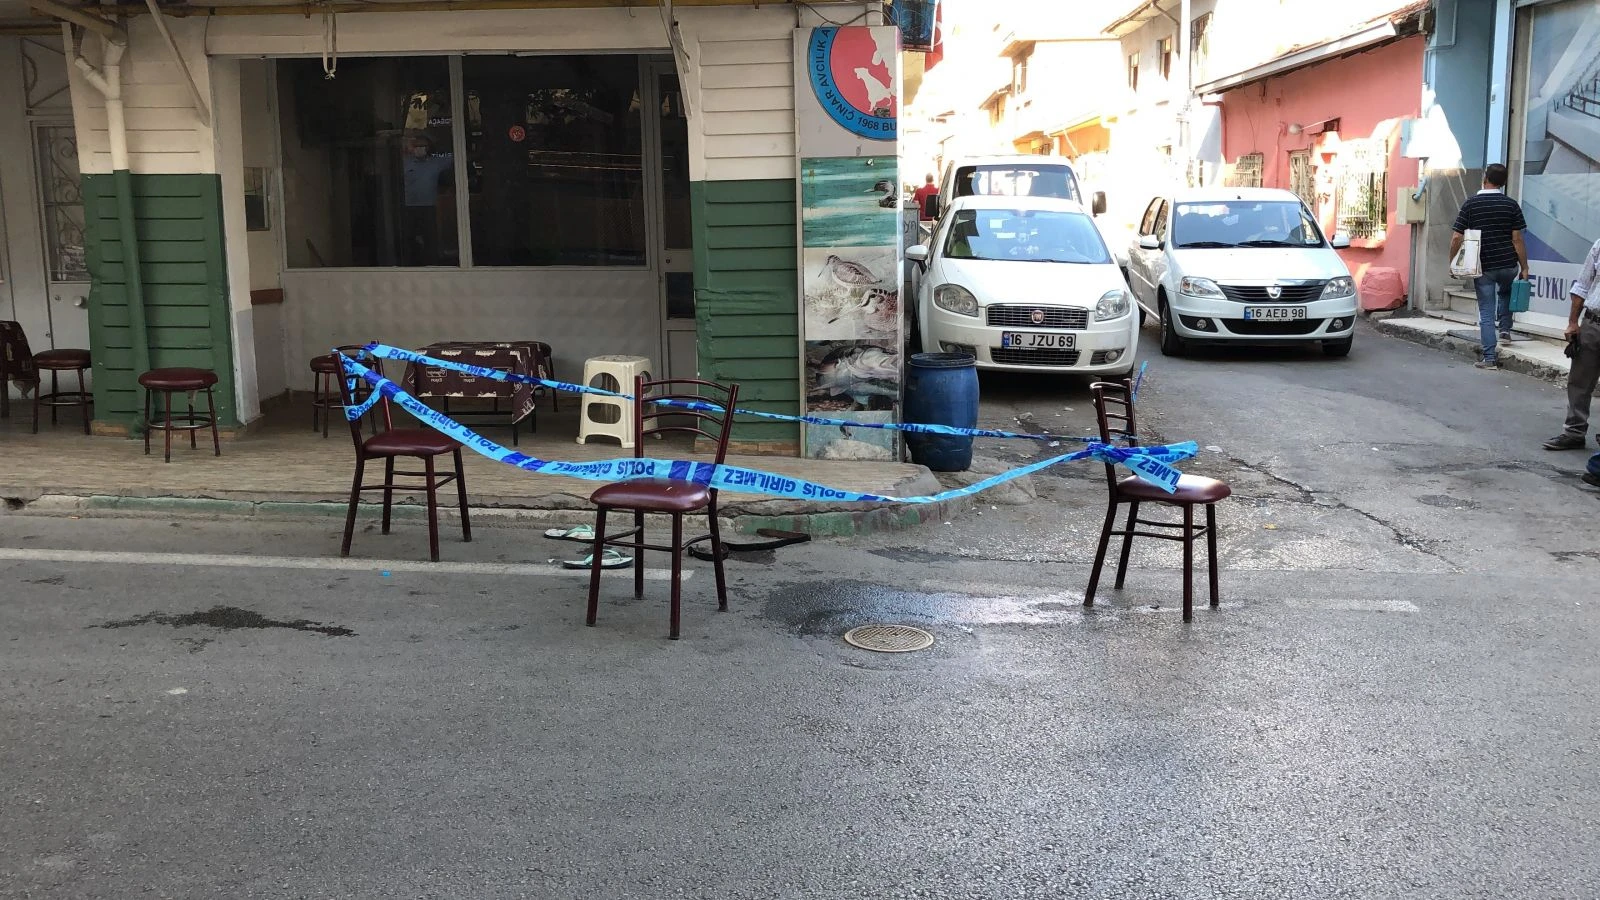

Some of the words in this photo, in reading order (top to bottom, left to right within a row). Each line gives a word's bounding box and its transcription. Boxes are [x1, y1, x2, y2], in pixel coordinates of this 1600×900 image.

[815, 40, 830, 87] AVCILIK
[825, 89, 855, 121] ÇINAR
[858, 117, 880, 131] 1968
[882, 121, 897, 132] BU
[1537, 275, 1568, 301] UYKU
[1250, 308, 1262, 318] 16
[1265, 308, 1288, 318] AEB
[1291, 308, 1304, 318] 98
[1009, 333, 1022, 346] 16
[1028, 334, 1055, 347] JZU
[1058, 335, 1074, 348] 69
[616, 460, 655, 479] POLİS
[724, 468, 796, 492] GİRİLMEZ
